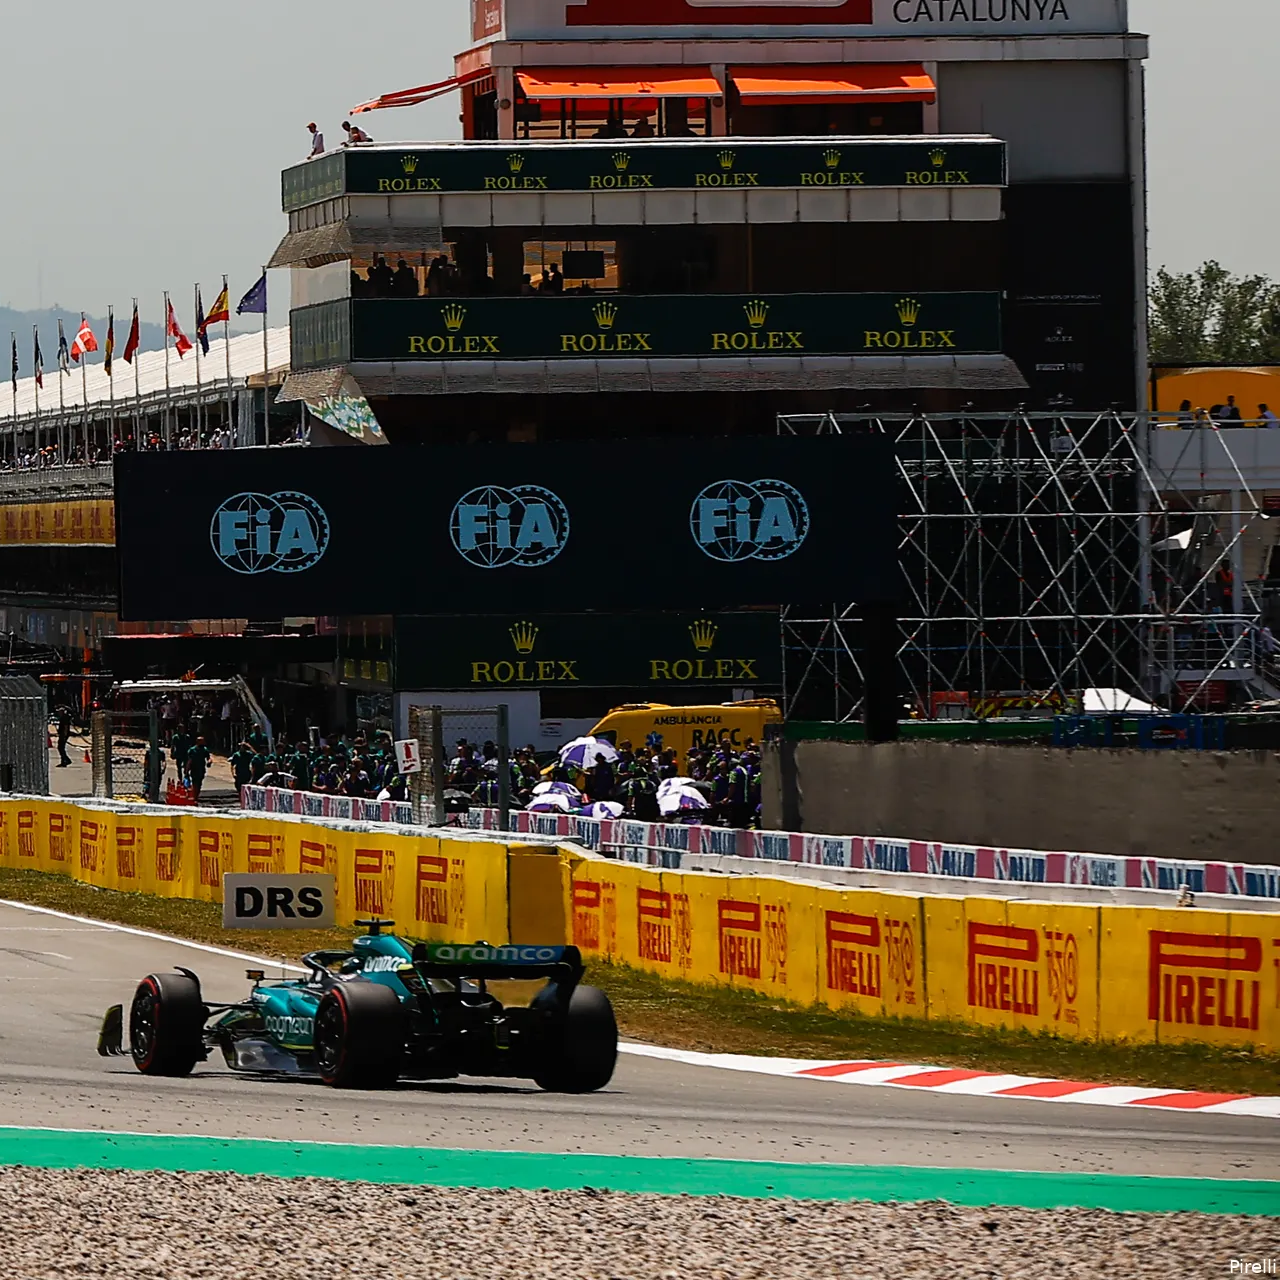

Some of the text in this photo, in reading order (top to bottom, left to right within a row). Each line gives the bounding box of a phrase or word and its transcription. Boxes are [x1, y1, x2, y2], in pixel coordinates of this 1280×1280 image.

[378, 179, 441, 191] ROLEX
[484, 177, 547, 189] ROLEX
[589, 175, 653, 187] ROLEX
[695, 173, 758, 186] ROLEX
[800, 172, 864, 185] ROLEX
[905, 171, 969, 184] ROLEX
[408, 335, 500, 354] ROLEX
[560, 333, 652, 352] ROLEX
[711, 331, 803, 350] ROLEX
[863, 330, 956, 348] ROLEX
[471, 660, 580, 683] ROLEX
[649, 659, 758, 681] ROLEX
[654, 715, 721, 725] AMBULANCIA
[692, 728, 741, 746] RACC
[235, 886, 324, 919] DRS
[718, 898, 761, 979] PIRELLI
[435, 945, 556, 961] aramco
[825, 910, 881, 998] PIRELLI
[967, 921, 1039, 1016] PIRELLI
[1148, 930, 1263, 1031] PIRELLI
